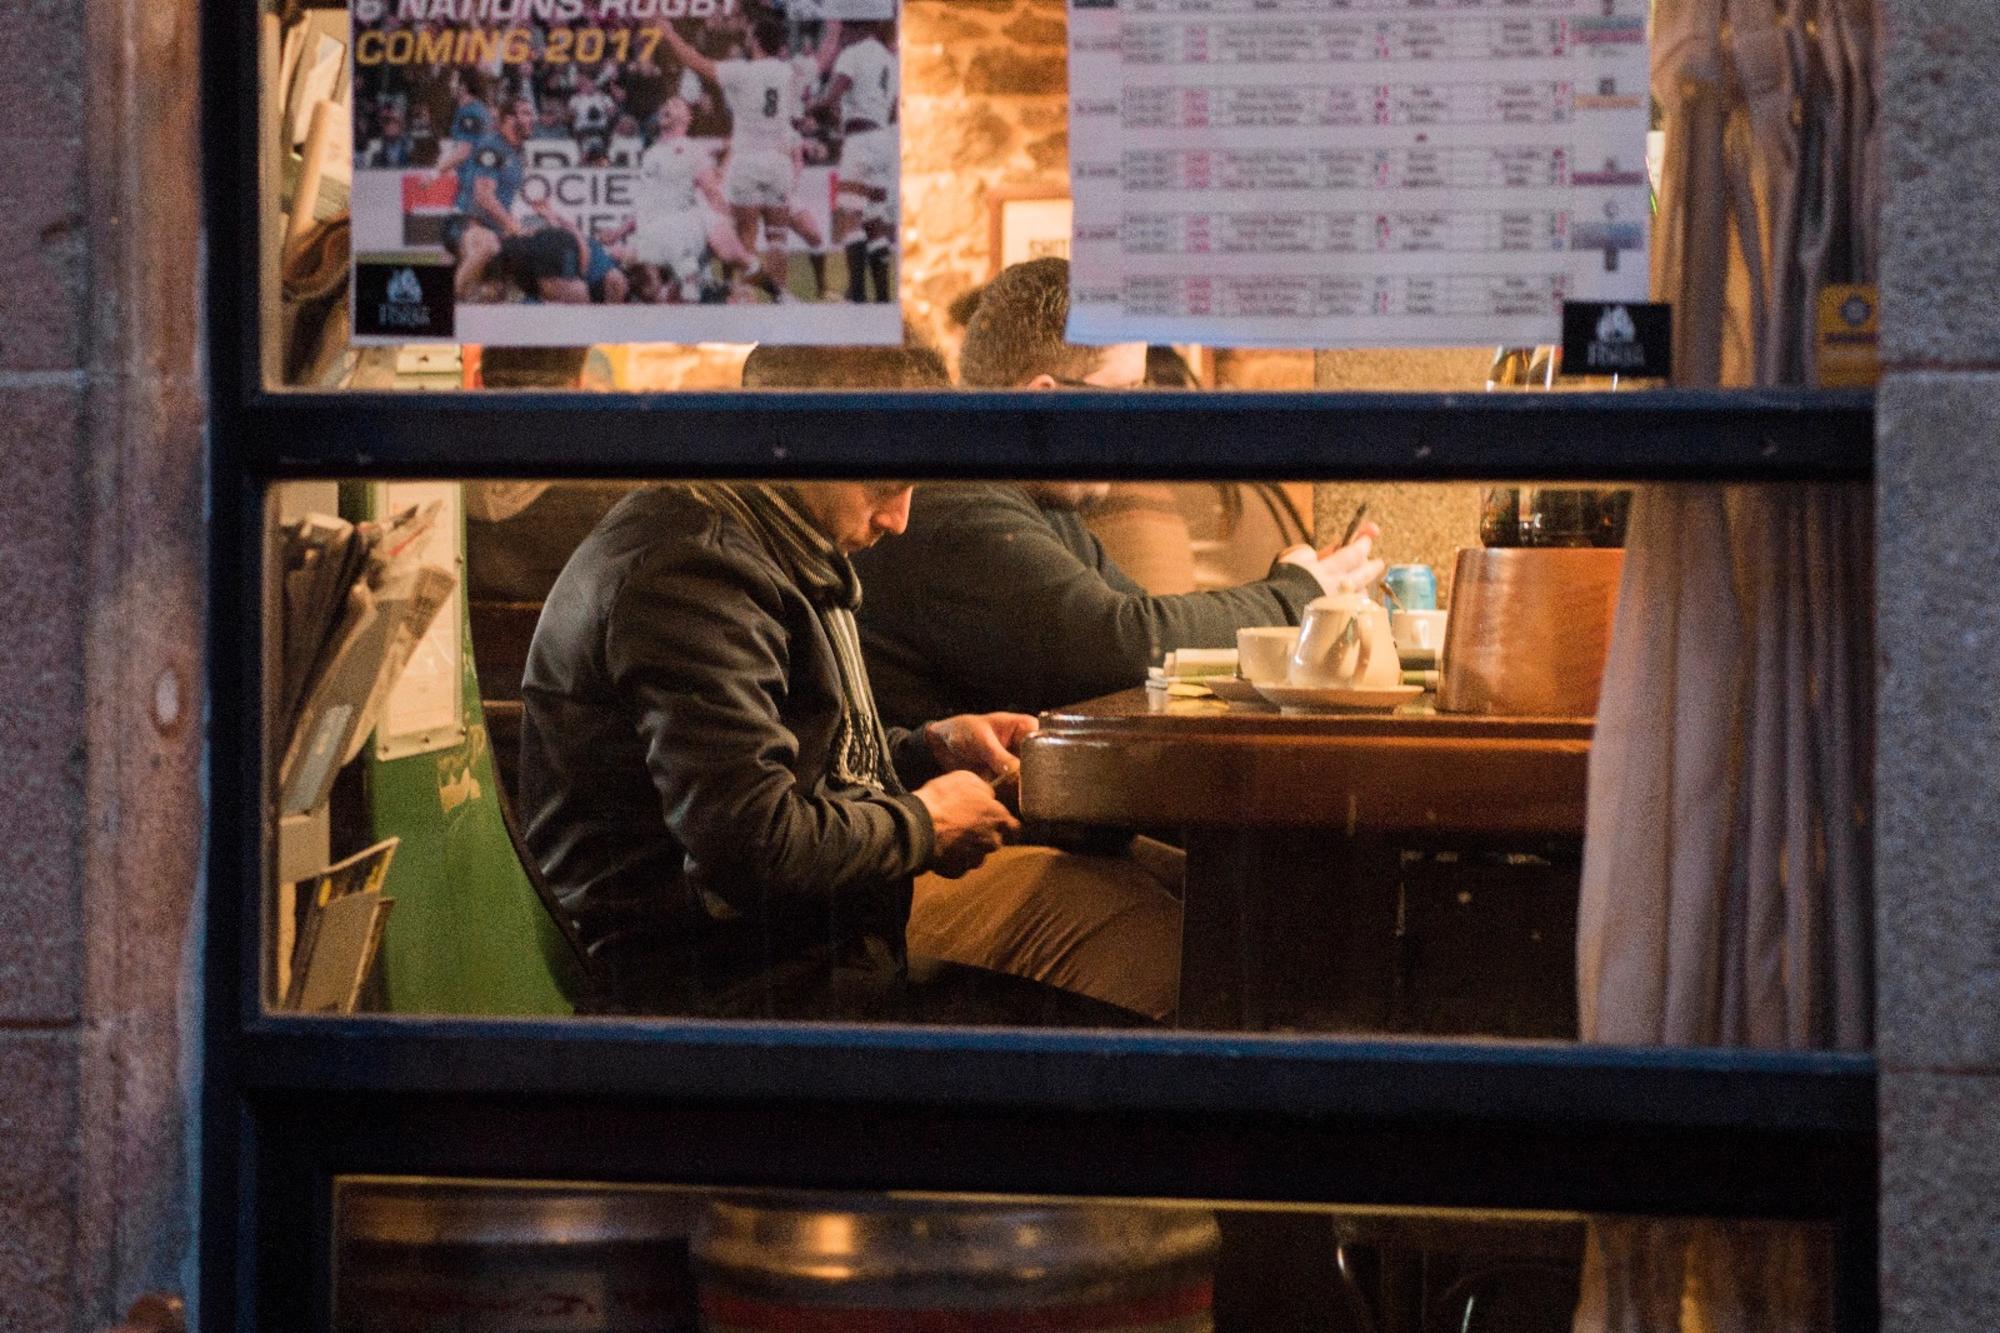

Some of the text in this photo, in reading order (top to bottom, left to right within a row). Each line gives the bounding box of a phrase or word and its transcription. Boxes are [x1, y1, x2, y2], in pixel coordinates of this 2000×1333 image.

[398, 0, 583, 19] NATIONS
[356, 27, 663, 65] COMING 2017
[521, 173, 641, 206] OCIE
